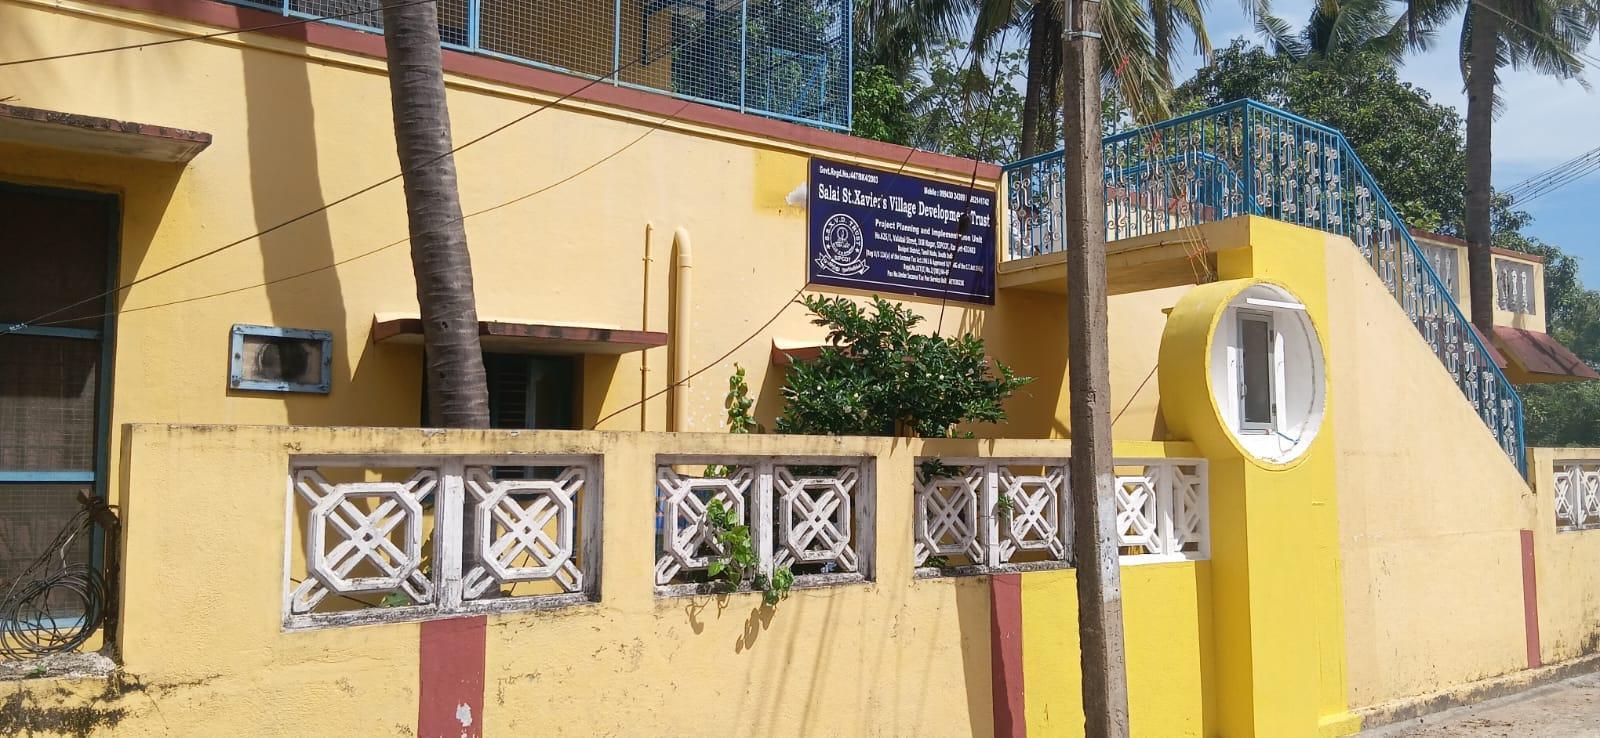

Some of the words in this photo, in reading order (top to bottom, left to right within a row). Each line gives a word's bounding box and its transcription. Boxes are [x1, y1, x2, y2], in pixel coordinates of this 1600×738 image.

[818, 183, 840, 202] Salai
[889, 195, 917, 218] Village
[918, 201, 968, 225] Developme
[970, 210, 991, 228] Trust
[875, 218, 896, 230] Project
[896, 221, 920, 235] Planning
[920, 226, 931, 235] and
[971, 234, 983, 244] Unit
